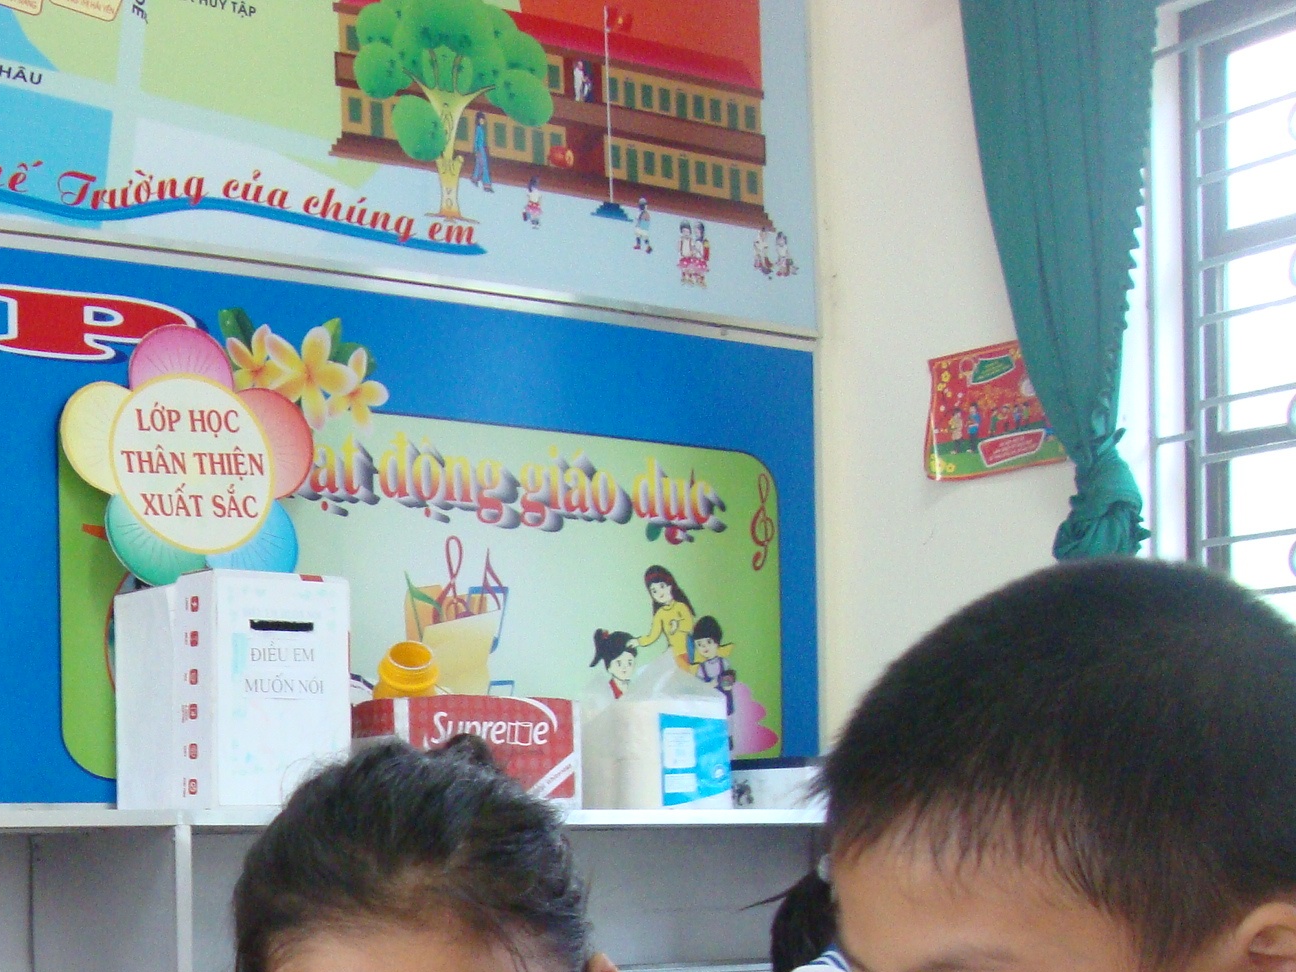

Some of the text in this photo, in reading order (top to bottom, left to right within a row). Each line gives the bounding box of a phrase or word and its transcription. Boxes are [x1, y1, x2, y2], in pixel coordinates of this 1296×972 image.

[231, 0, 257, 18] TẬP
[57, 168, 210, 211] Trường
[222, 168, 293, 211] của
[302, 187, 416, 243] chúng
[427, 219, 477, 246] em
[134, 401, 240, 438] LỚP HỌC
[120, 444, 265, 481] THÂN THIỆN
[306, 432, 376, 516] ạt
[378, 430, 510, 524] động
[518, 443, 624, 529] giáo
[140, 483, 259, 518] XUẤT SẮC
[250, 640, 315, 662] ĐIỀU EM
[244, 672, 324, 695] MUỐN NÓI
